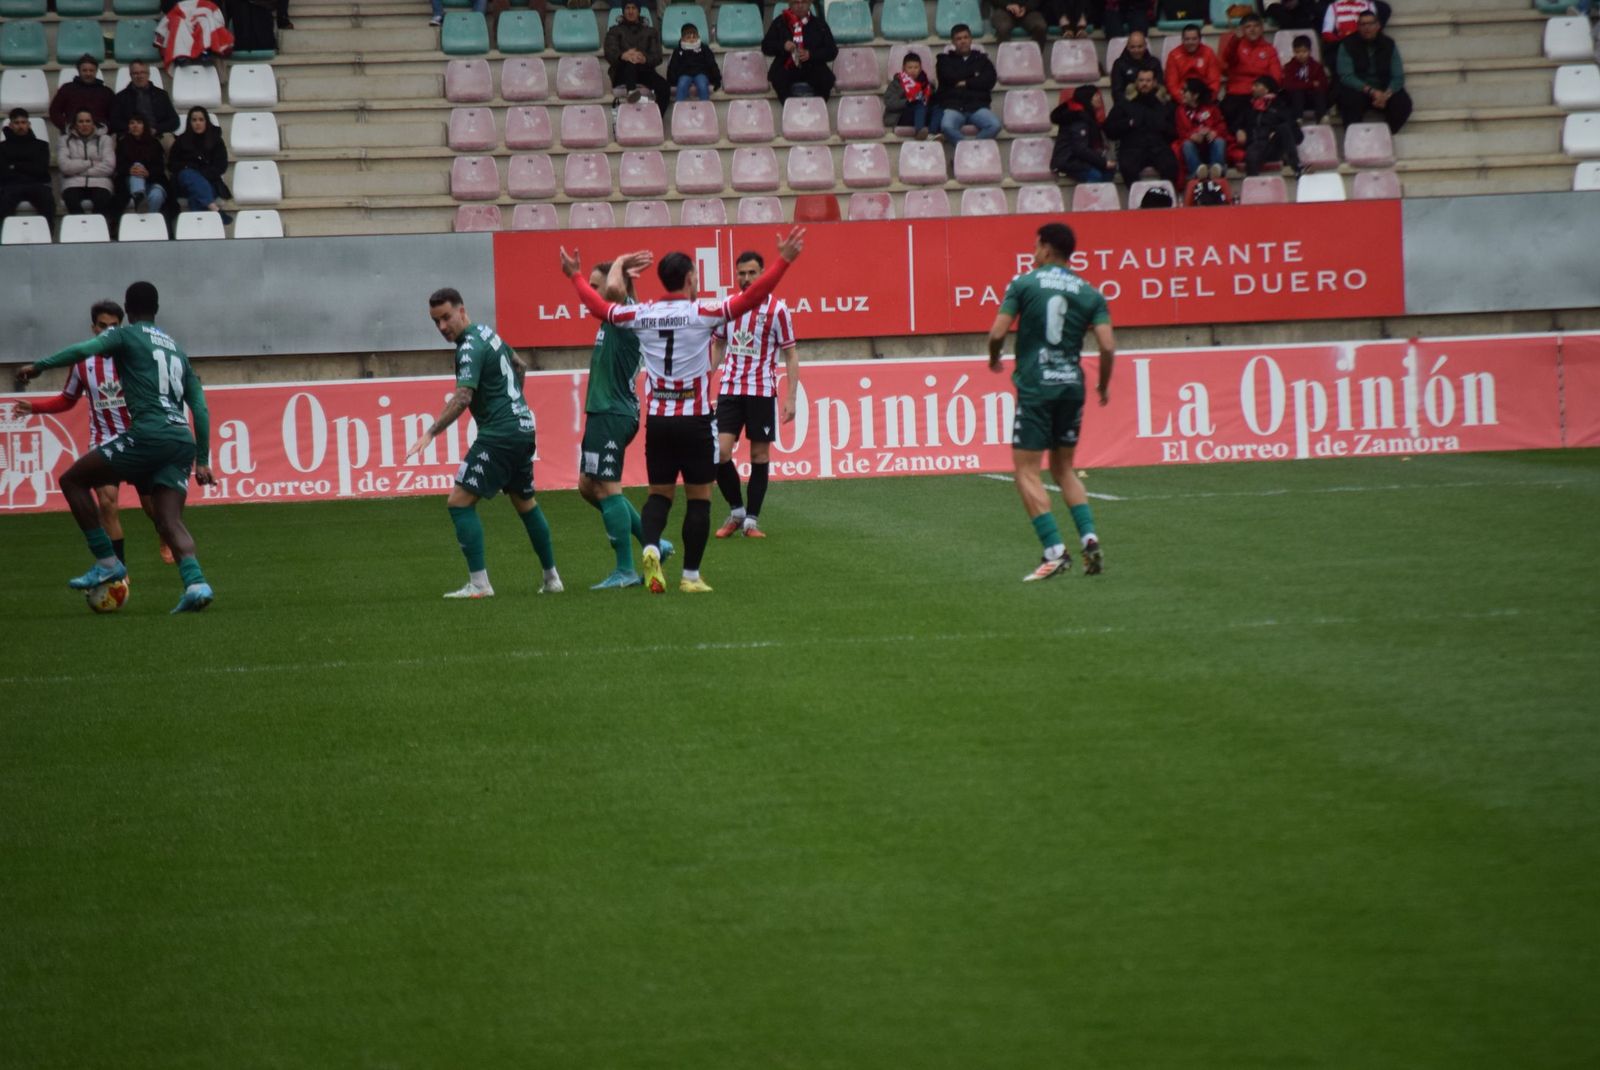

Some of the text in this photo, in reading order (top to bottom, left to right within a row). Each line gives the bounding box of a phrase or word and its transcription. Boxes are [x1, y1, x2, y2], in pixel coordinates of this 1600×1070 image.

[1016, 240, 1304, 275] RSTAURANTE
[1141, 276, 1216, 299] DEL
[1233, 268, 1368, 295] DUERO
[538, 304, 572, 320] LA
[821, 296, 870, 313] LUZ
[658, 329, 674, 376] 7
[1132, 357, 1217, 438] La
[1239, 354, 1500, 460] Opinión
[772, 373, 1016, 478] Opinión
[281, 391, 541, 497] Opini
[1162, 432, 1460, 462] El Correo de Zamora
[838, 452, 870, 474] de
[876, 452, 981, 473] Zamora
[202, 470, 457, 499] El Correo de Zam
